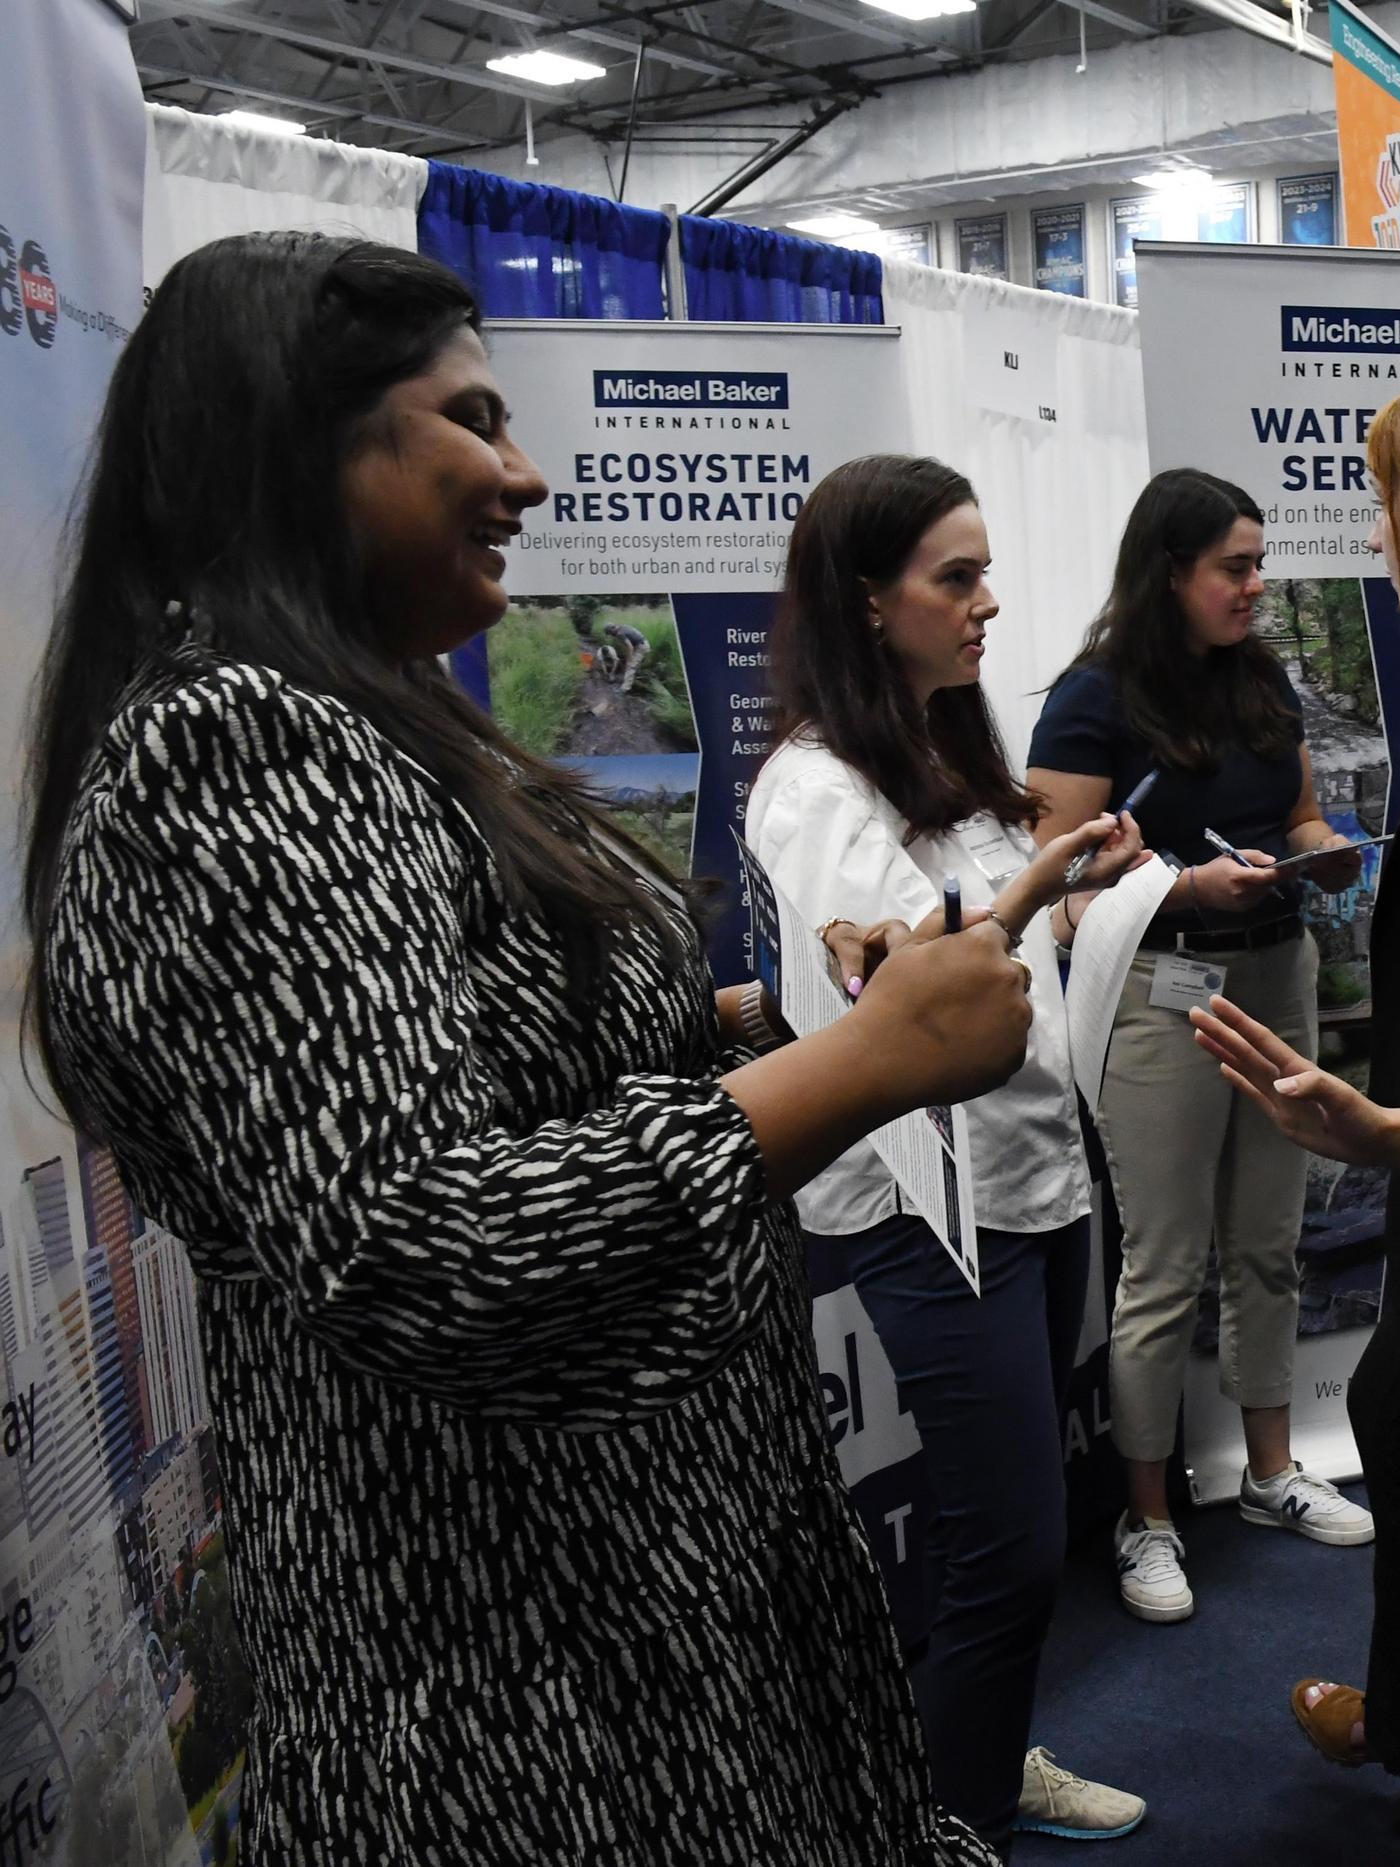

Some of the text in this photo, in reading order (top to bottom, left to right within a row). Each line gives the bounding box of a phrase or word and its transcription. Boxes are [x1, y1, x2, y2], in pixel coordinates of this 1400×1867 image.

[23, 279, 54, 306] YEARS
[1292, 317, 1400, 344] Michael
[602, 378, 781, 402] Michael Baker
[594, 415, 791, 430] INTERNATIONAL
[574, 453, 810, 483] ECOSYSTEM
[1285, 508, 1307, 523] on
[1314, 503, 1344, 523] the
[520, 532, 607, 553] Delivering
[612, 533, 701, 553] ecosystem
[561, 558, 585, 576] for
[589, 558, 626, 575] both
[631, 558, 679, 575] urban
[684, 557, 715, 575] and
[720, 557, 760, 574] rural
[726, 628, 767, 644] River
[732, 716, 744, 733] &
[1315, 1379, 1342, 1400] We
[1, 1382, 35, 1465] ay
